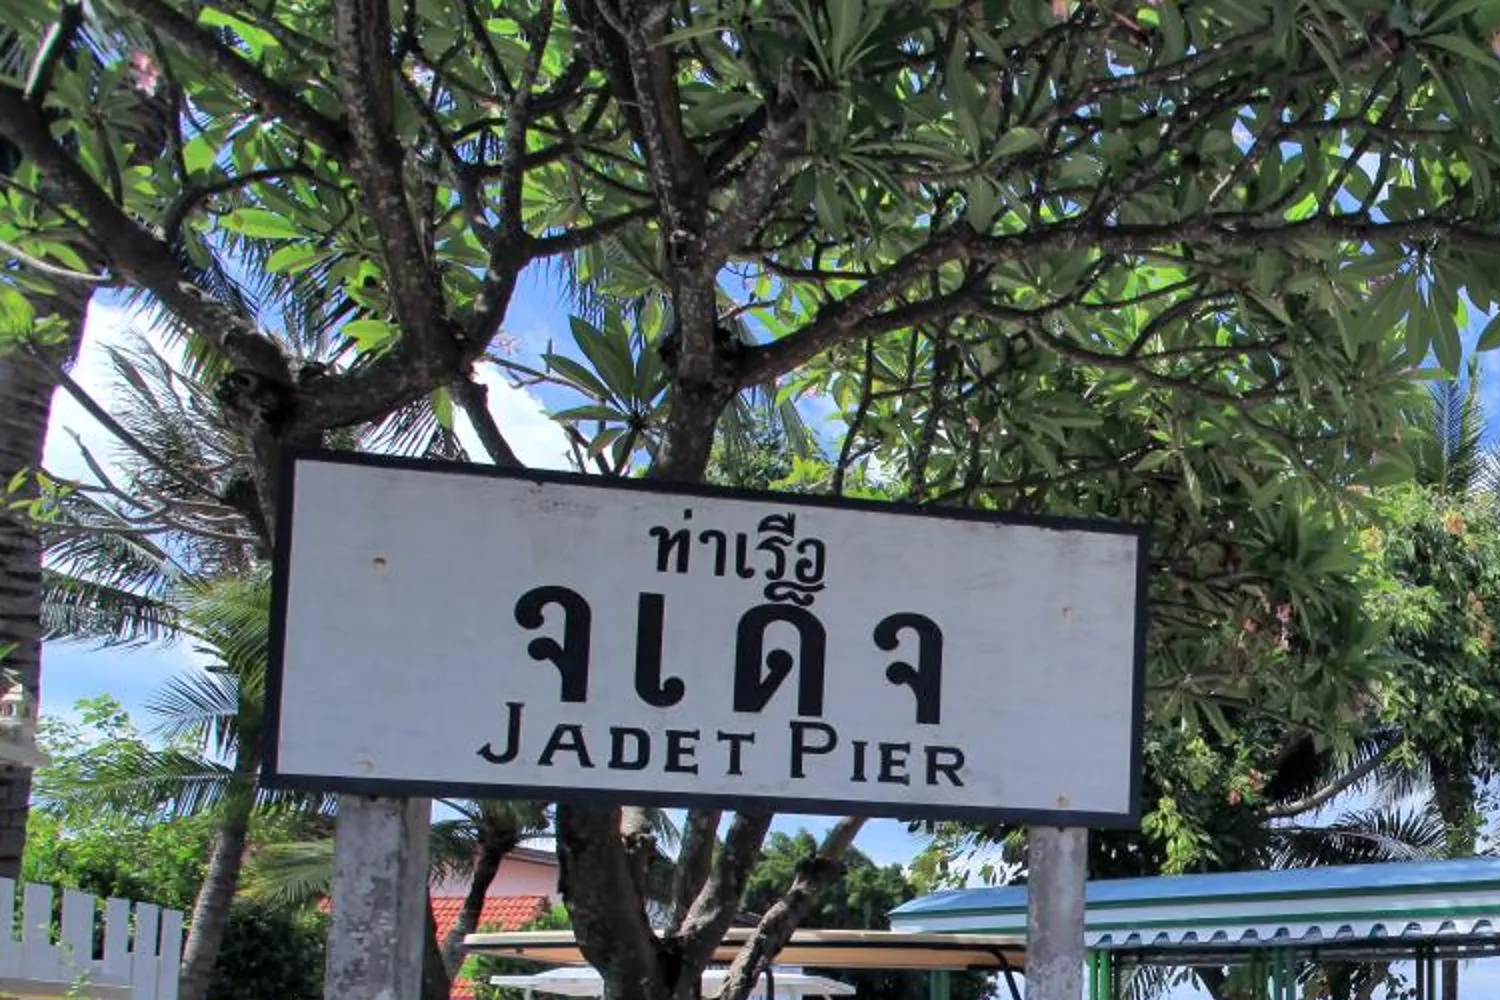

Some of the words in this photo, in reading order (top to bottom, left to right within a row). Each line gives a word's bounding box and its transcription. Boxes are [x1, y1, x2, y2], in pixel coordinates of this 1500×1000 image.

[648, 508, 826, 585] ท่าเรือ
[513, 581, 944, 725] จเด็จ
[477, 702, 756, 776] JADET
[790, 720, 966, 787] PIER
